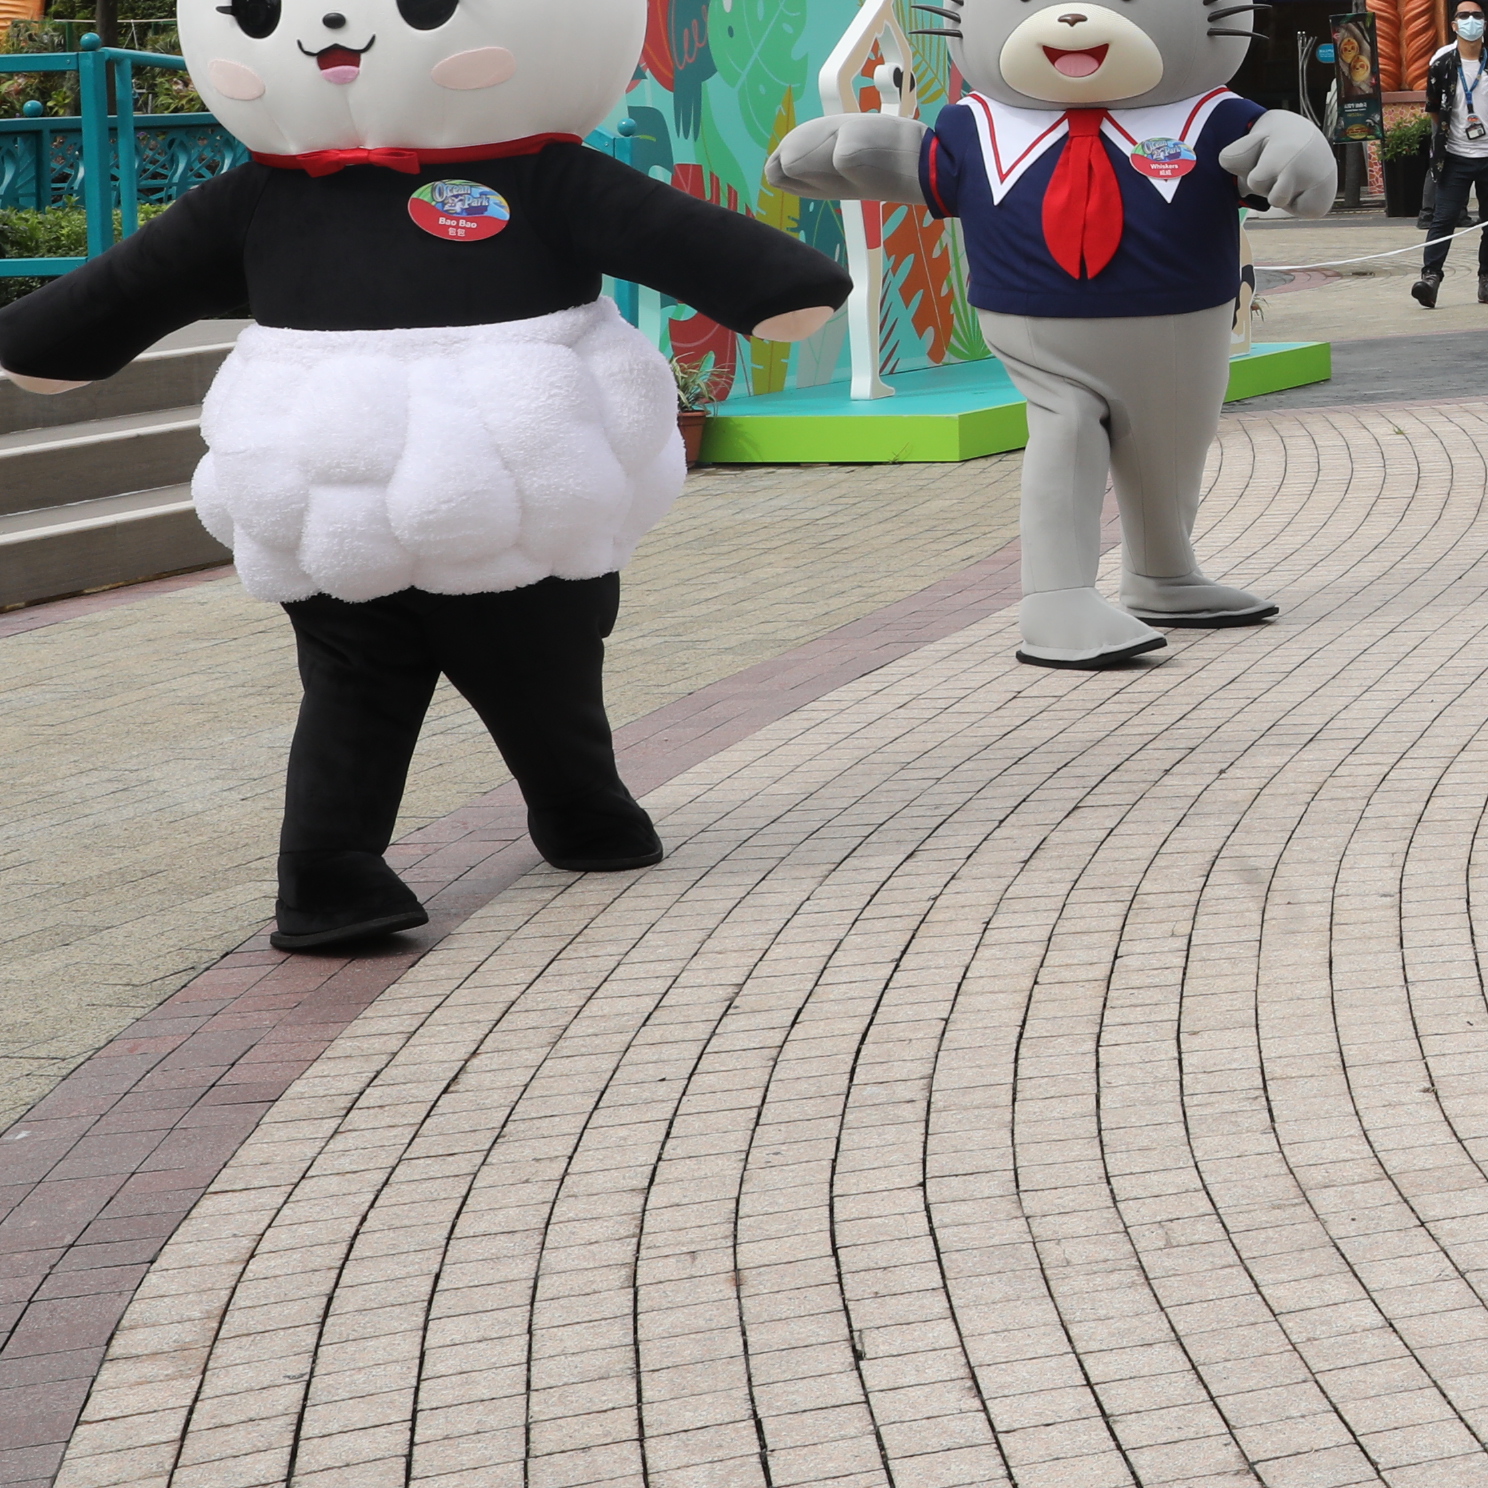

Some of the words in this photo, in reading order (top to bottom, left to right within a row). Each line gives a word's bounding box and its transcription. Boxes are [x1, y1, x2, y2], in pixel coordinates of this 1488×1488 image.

[431, 180, 471, 202] Ocean
[462, 194, 490, 209] Park
[438, 216, 457, 226] Bao
[458, 218, 477, 229] Bao
